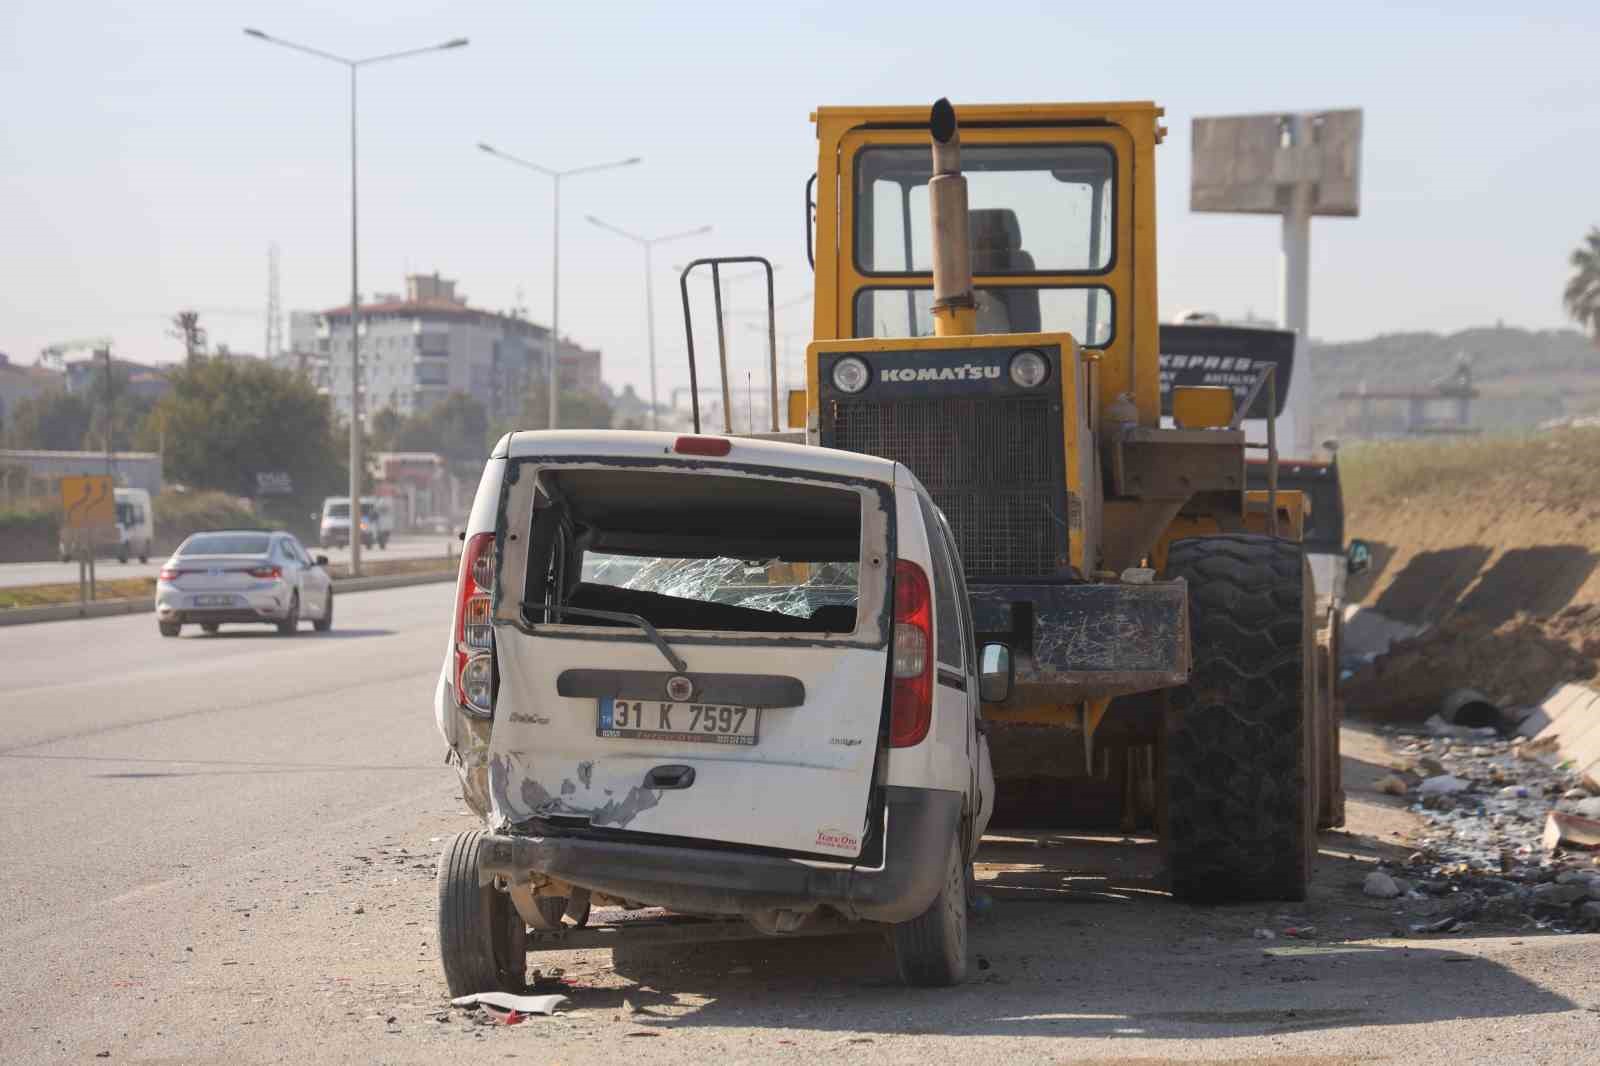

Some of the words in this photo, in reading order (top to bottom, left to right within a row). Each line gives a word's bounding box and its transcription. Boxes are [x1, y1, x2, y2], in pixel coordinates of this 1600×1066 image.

[881, 363, 1000, 382] KOMATSU
[615, 701, 641, 728] 31
[658, 703, 673, 730] K
[689, 704, 746, 733] 7597
